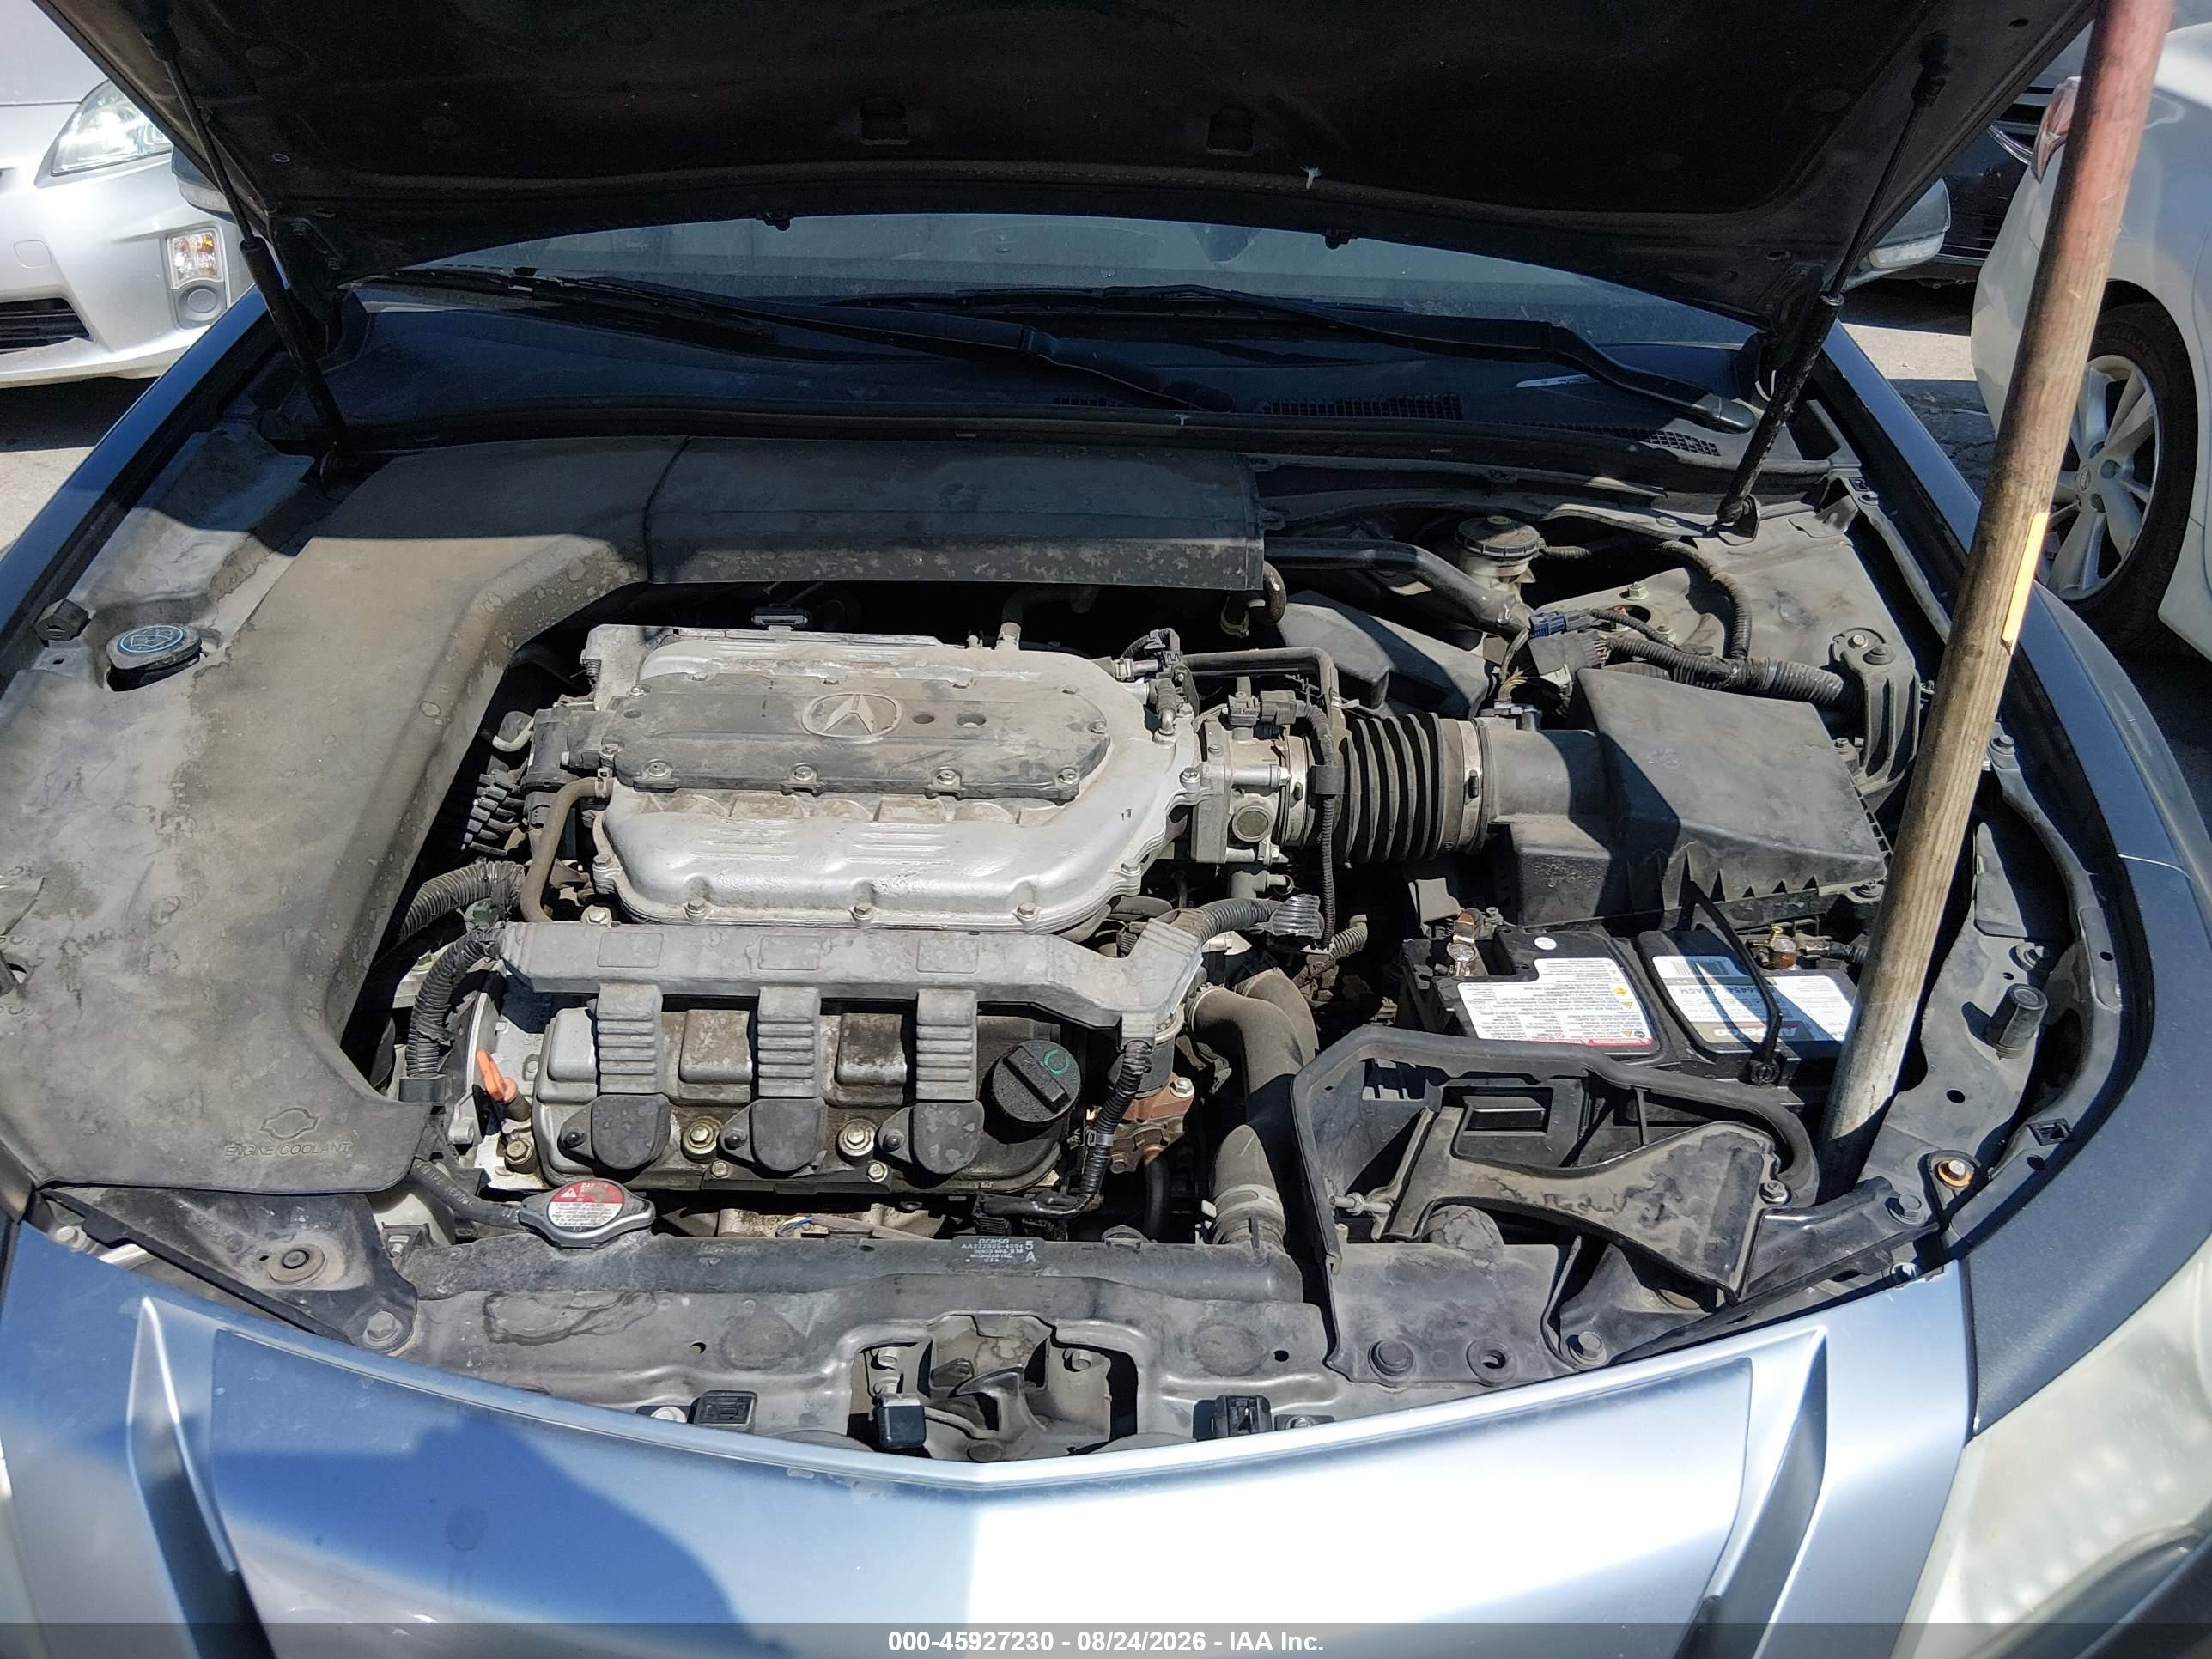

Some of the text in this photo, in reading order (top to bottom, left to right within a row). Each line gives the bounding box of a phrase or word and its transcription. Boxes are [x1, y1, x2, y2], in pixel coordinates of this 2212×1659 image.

[1713, 1028, 1797, 1037] ADelco
[279, 1142, 353, 1156] COOLANT
[1025, 1240, 1034, 1250] 5
[1024, 1251, 1036, 1262] A
